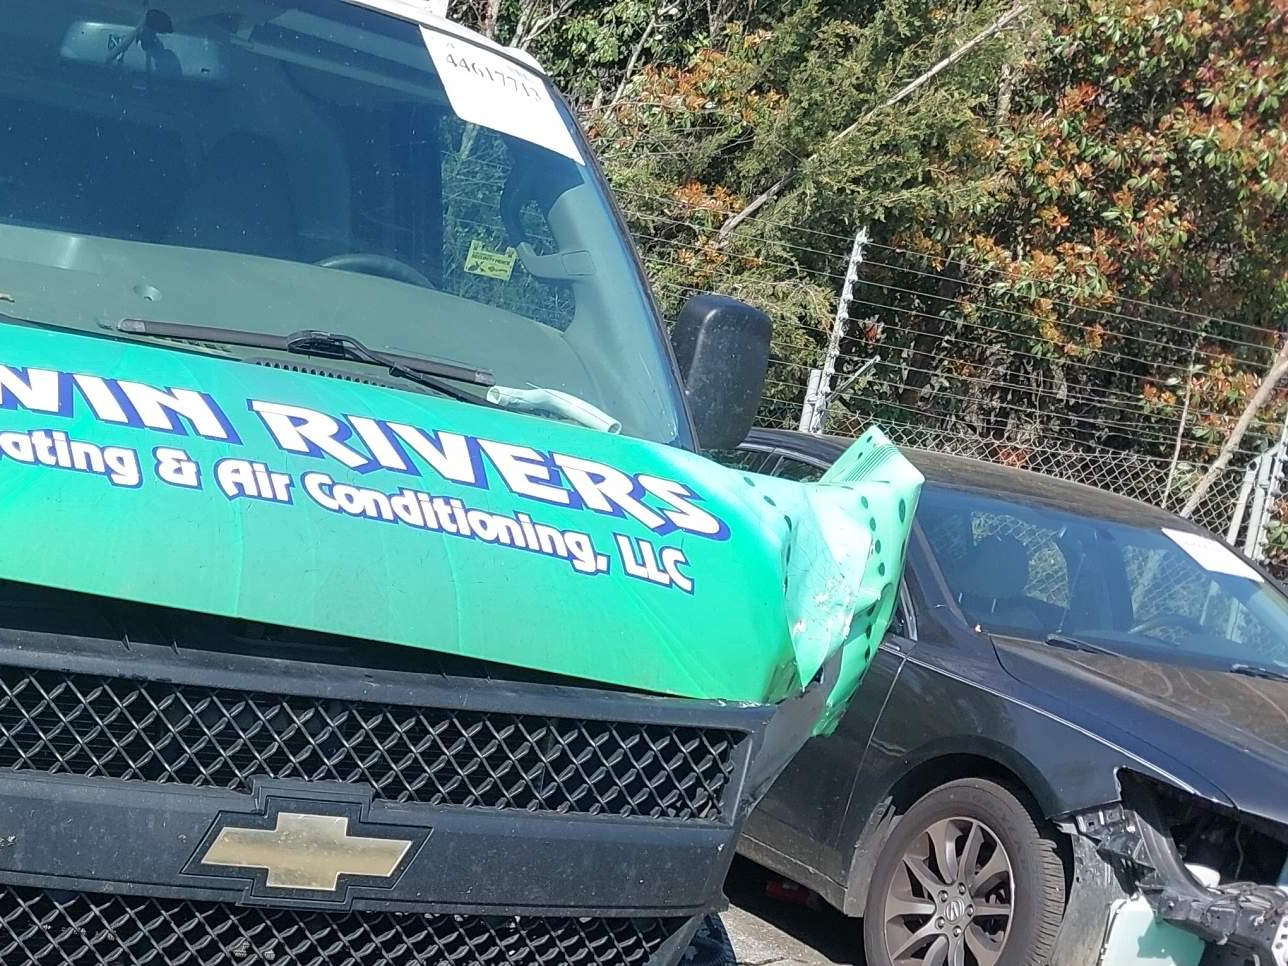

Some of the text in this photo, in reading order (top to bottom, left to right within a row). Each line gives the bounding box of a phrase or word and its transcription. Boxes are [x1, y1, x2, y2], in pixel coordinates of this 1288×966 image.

[152, 445, 202, 490] &
[214, 457, 293, 504] Air
[302, 471, 610, 575] Conditioning,
[612, 532, 694, 594] LLC
[247, 399, 731, 541] RIVERS
